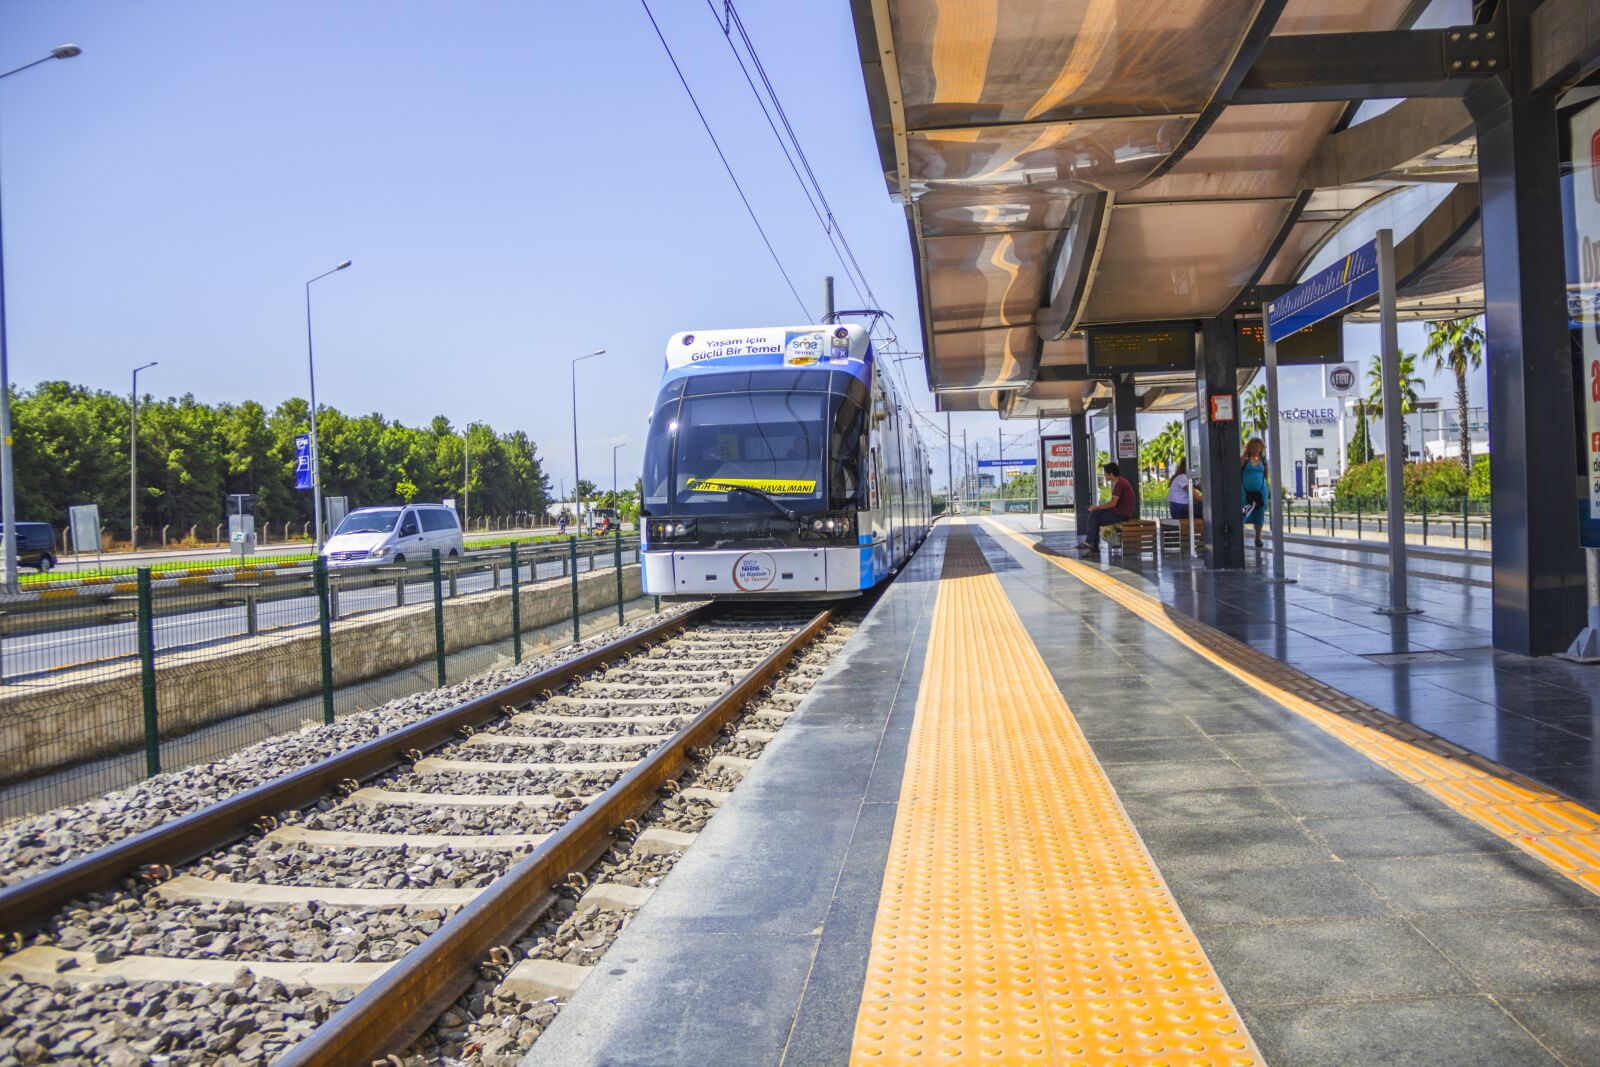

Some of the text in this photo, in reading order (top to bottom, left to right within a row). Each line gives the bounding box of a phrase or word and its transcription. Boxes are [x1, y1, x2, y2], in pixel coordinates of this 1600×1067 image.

[706, 339, 743, 348] Yaşam
[691, 344, 781, 361] Güçlü Bir Temel
[1335, 373, 1350, 384] FIAT
[1279, 408, 1334, 419] YEĞENLER
